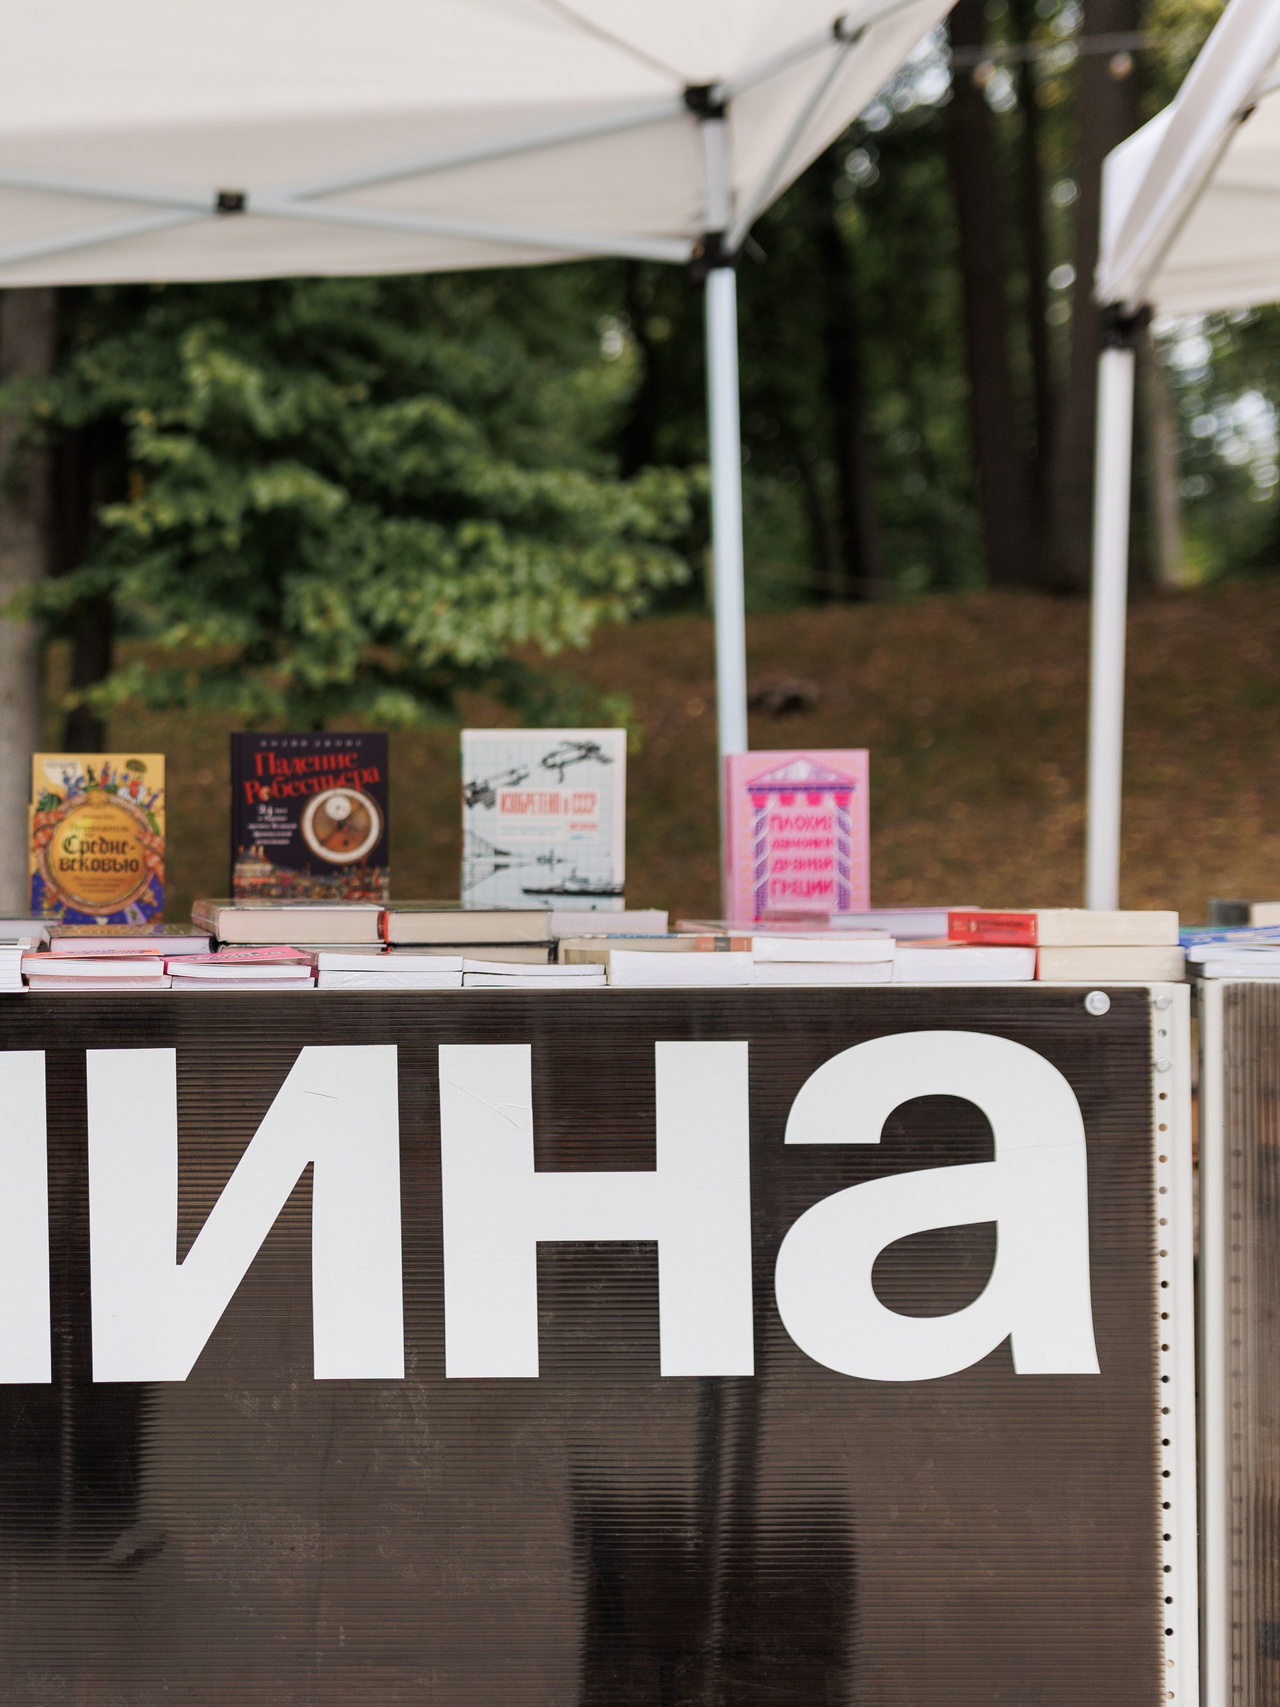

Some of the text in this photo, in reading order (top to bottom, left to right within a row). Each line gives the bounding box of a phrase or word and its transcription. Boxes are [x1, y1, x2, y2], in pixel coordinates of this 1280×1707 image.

[254, 750, 359, 777] Падение
[243, 765, 382, 805] Робеспьера
[63, 834, 136, 857] Средне-
[59, 857, 140, 873] вековью
